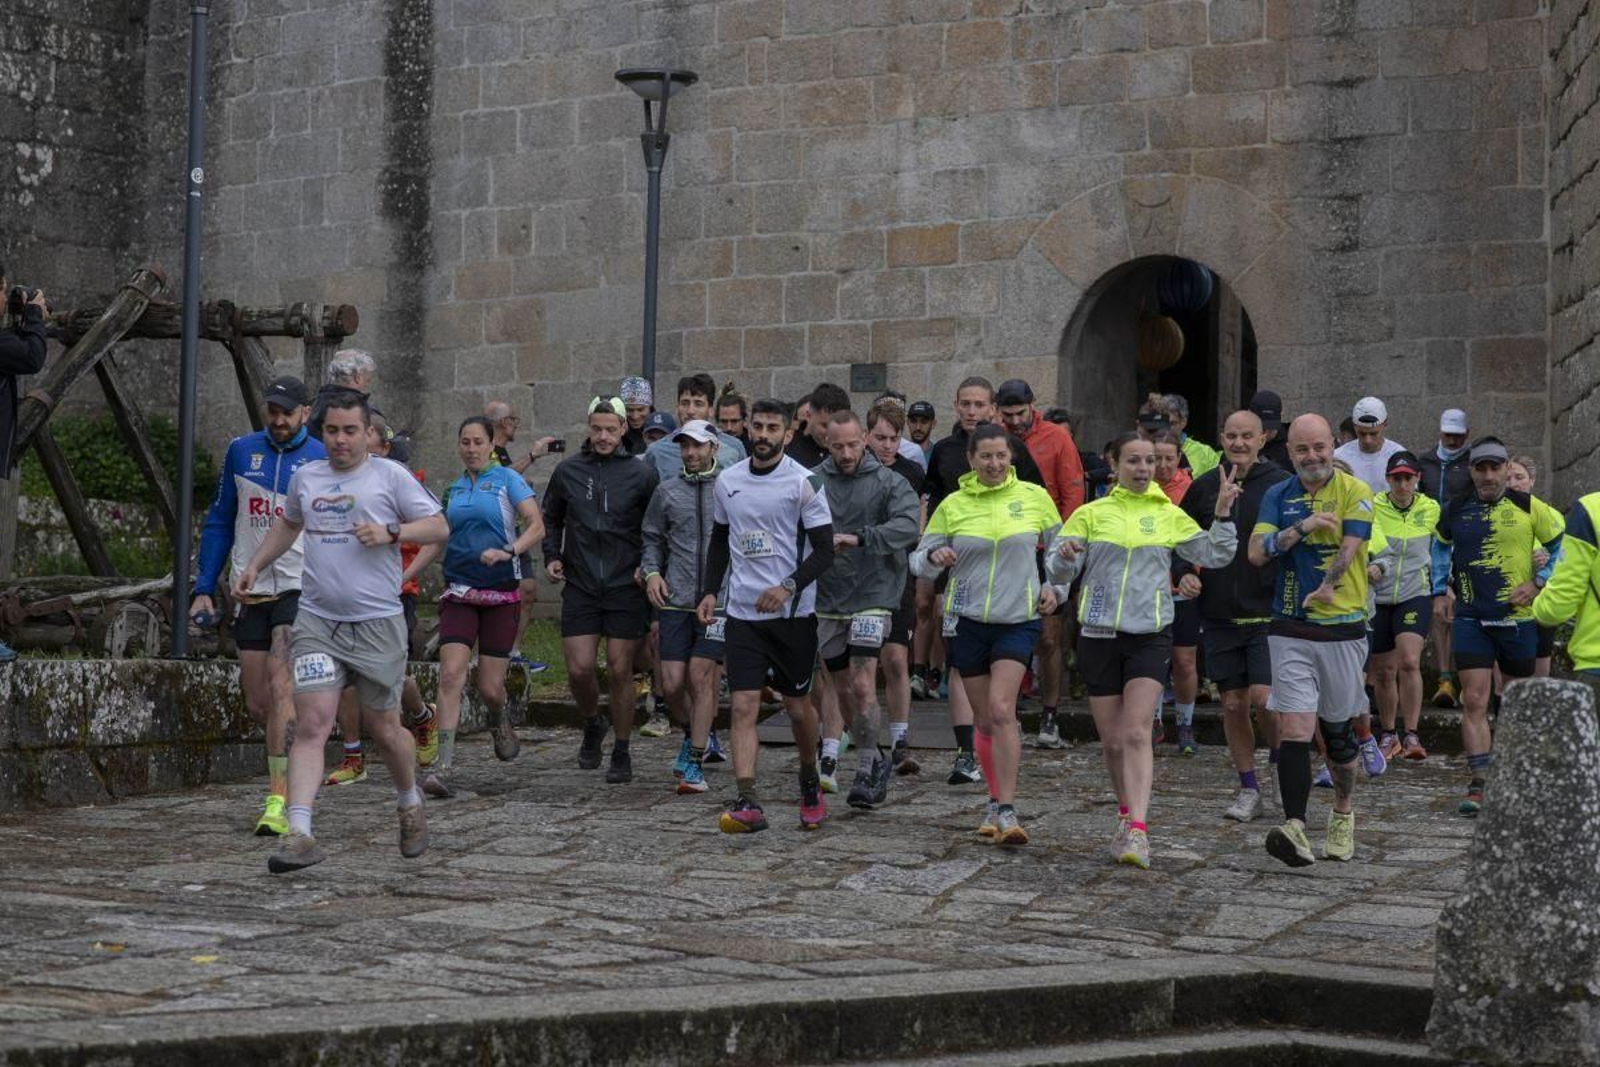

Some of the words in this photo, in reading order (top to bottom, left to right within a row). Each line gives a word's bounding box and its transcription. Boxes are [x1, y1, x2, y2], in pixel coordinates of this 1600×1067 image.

[746, 538, 763, 550] 164
[1087, 585, 1106, 628] SERRES
[1281, 570, 1296, 616] SERRES
[303, 662, 325, 676] 153
